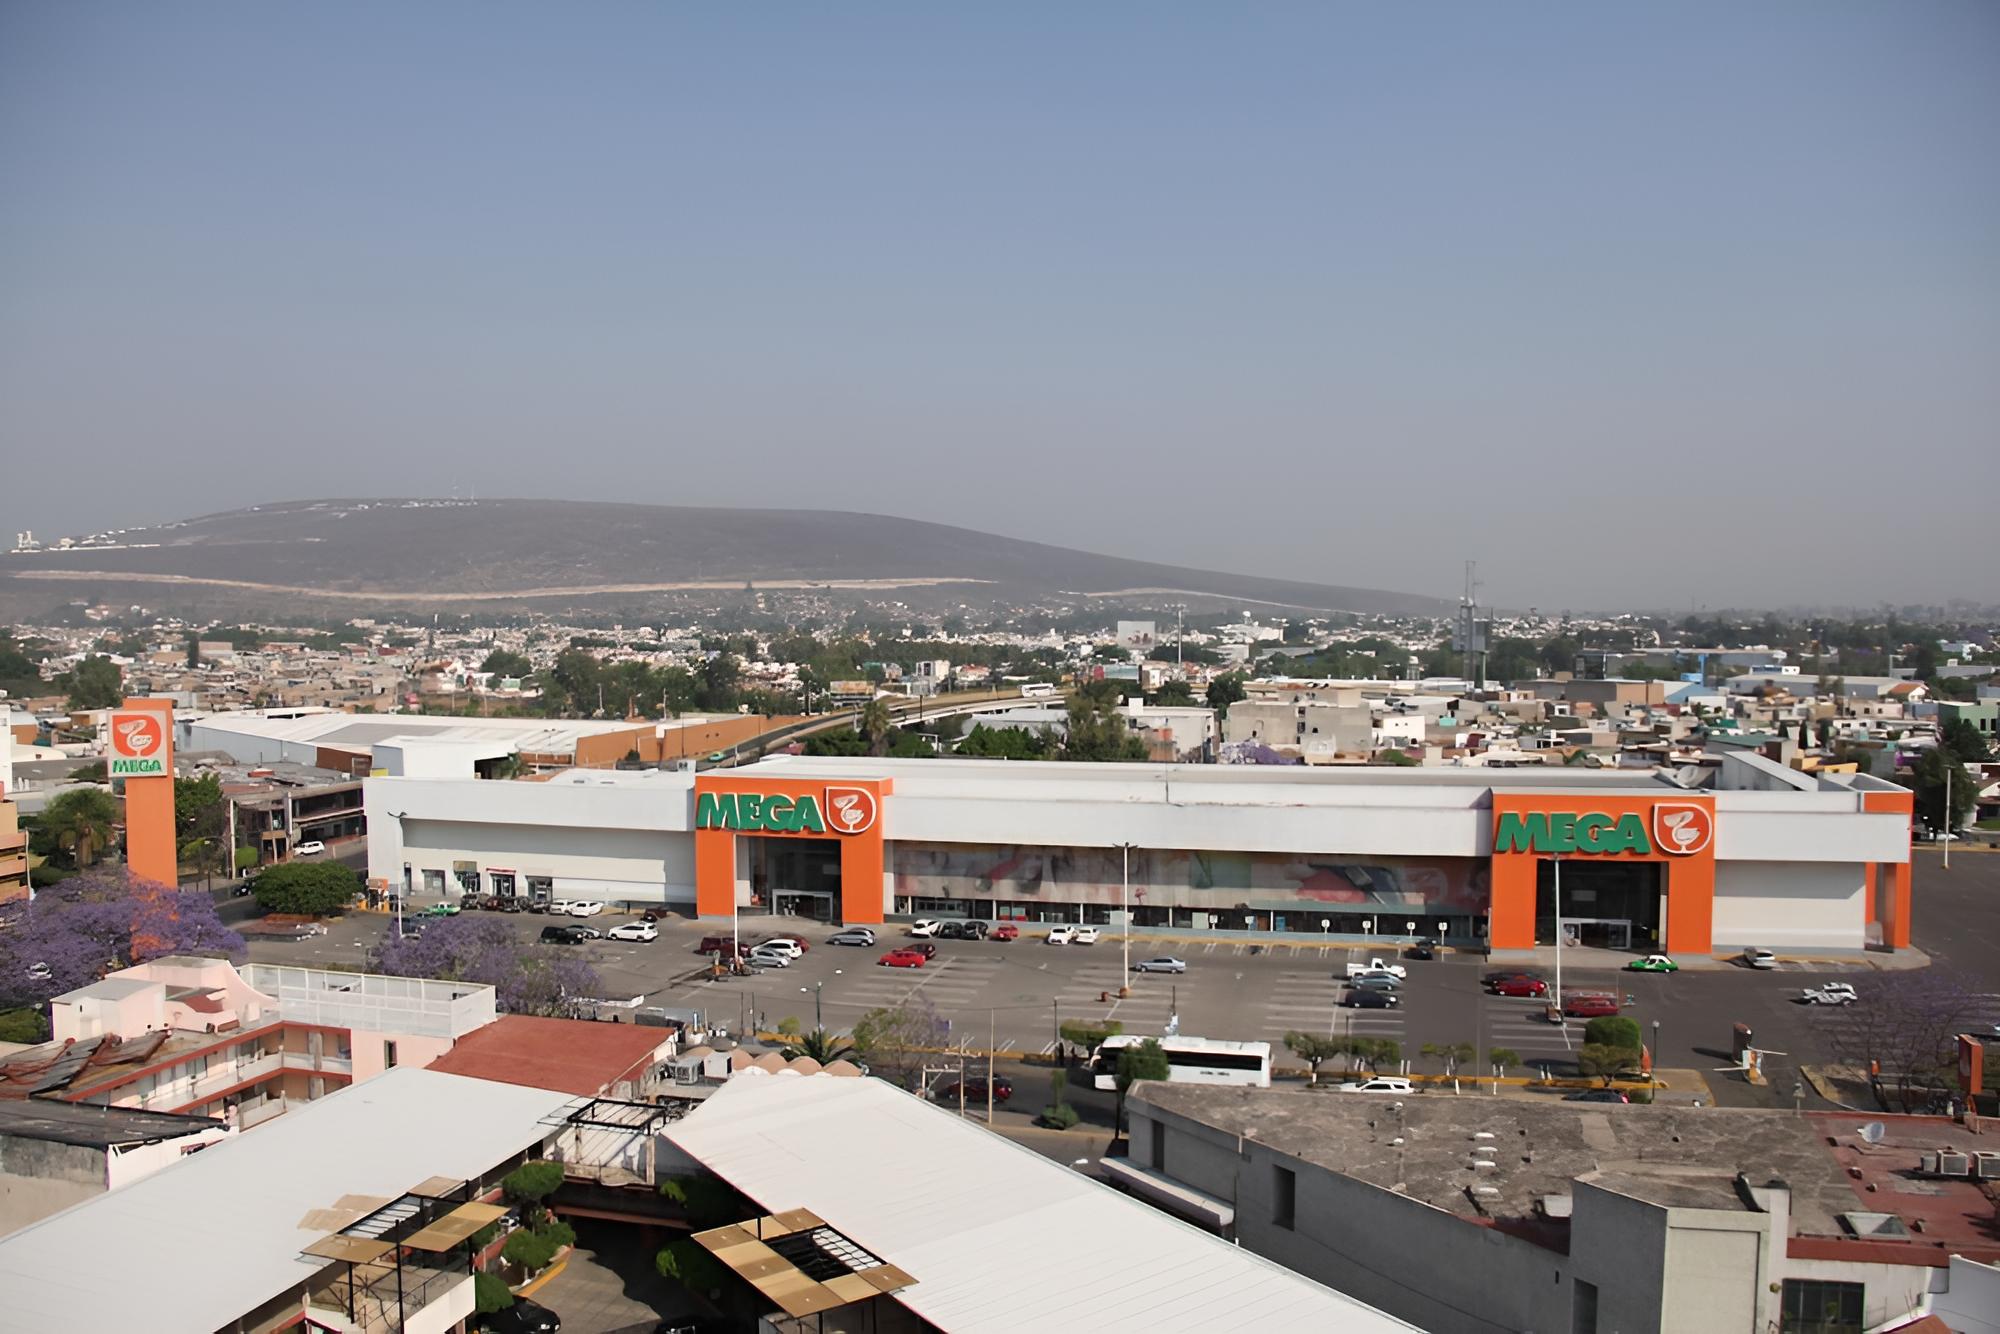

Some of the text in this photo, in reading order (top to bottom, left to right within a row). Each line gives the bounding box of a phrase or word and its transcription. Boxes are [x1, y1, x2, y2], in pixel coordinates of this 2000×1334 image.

[112, 759, 162, 773] MEGA
[696, 792, 827, 832] MEGA
[1495, 811, 1652, 854] MEGA
